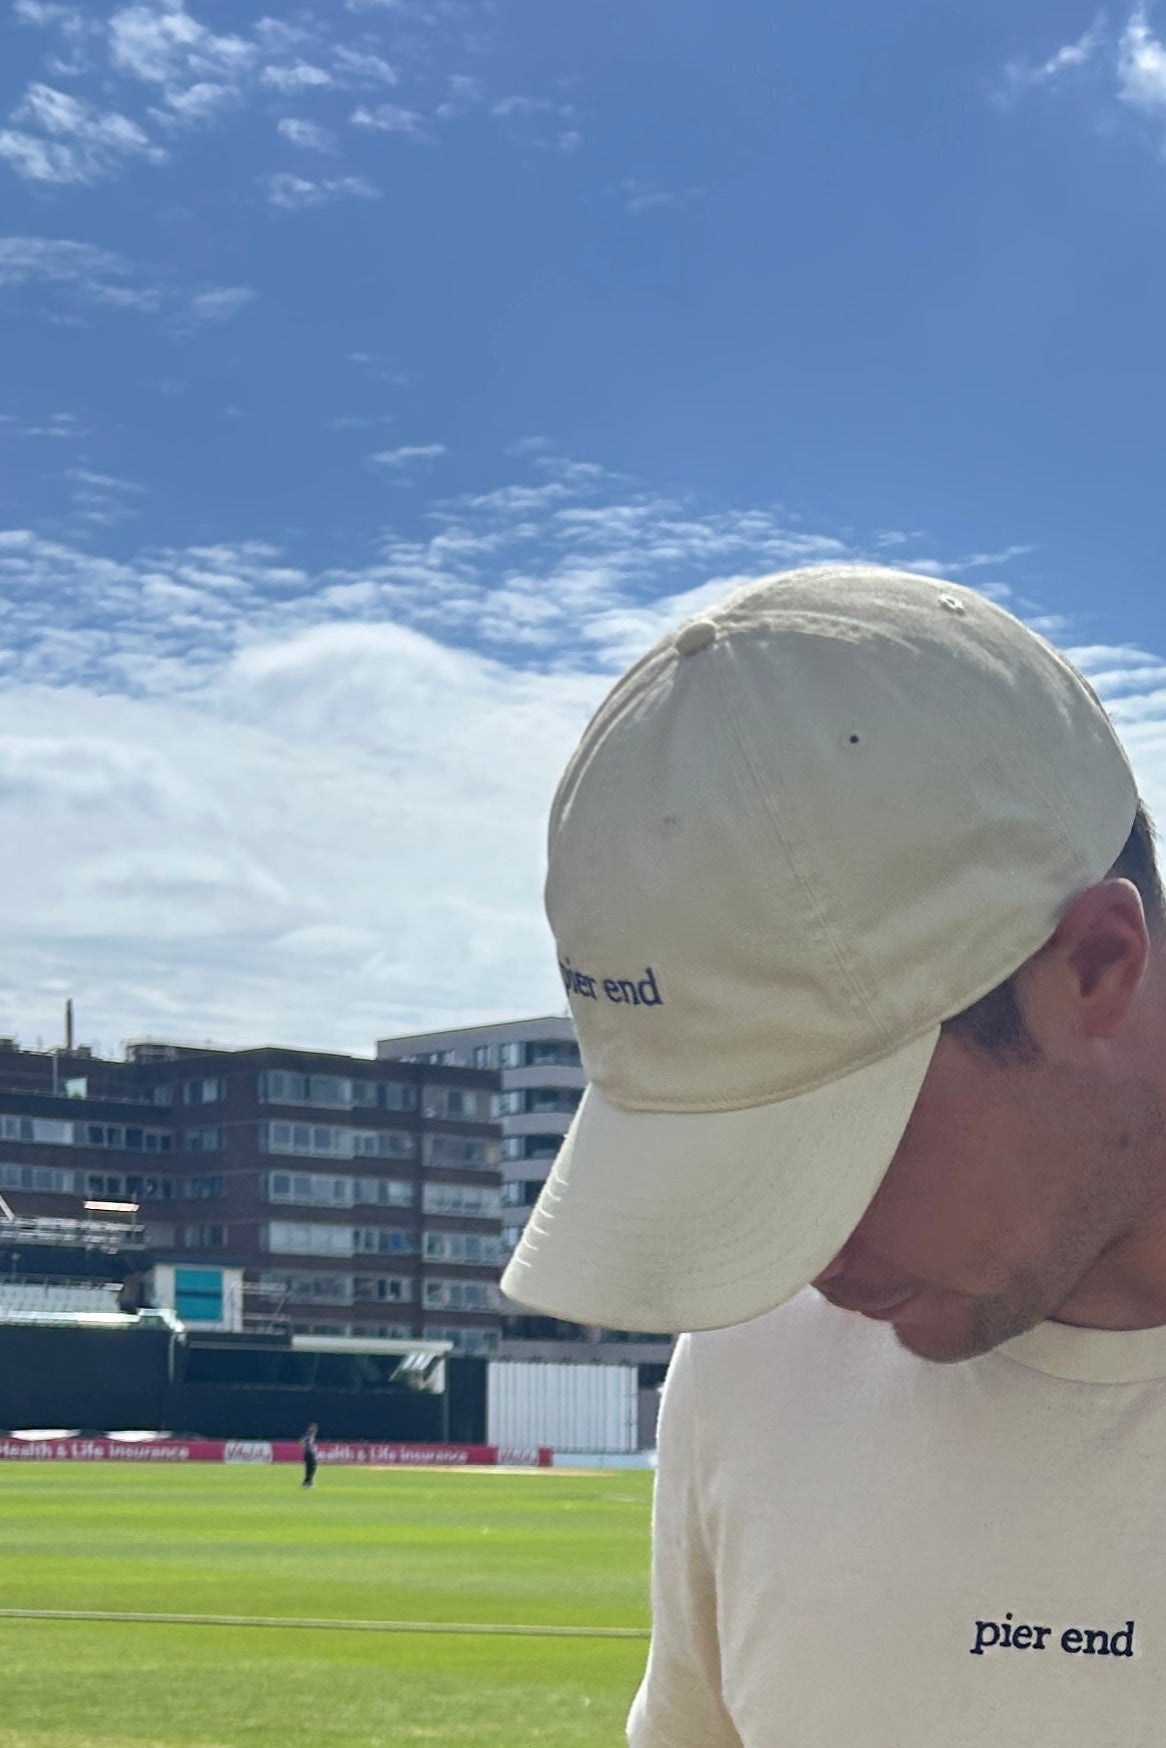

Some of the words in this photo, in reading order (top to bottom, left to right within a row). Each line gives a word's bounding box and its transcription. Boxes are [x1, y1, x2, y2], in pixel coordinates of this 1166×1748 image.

[603, 967, 664, 1006] end
[970, 1612, 1052, 1655] pier
[1061, 1621, 1135, 1657] end
